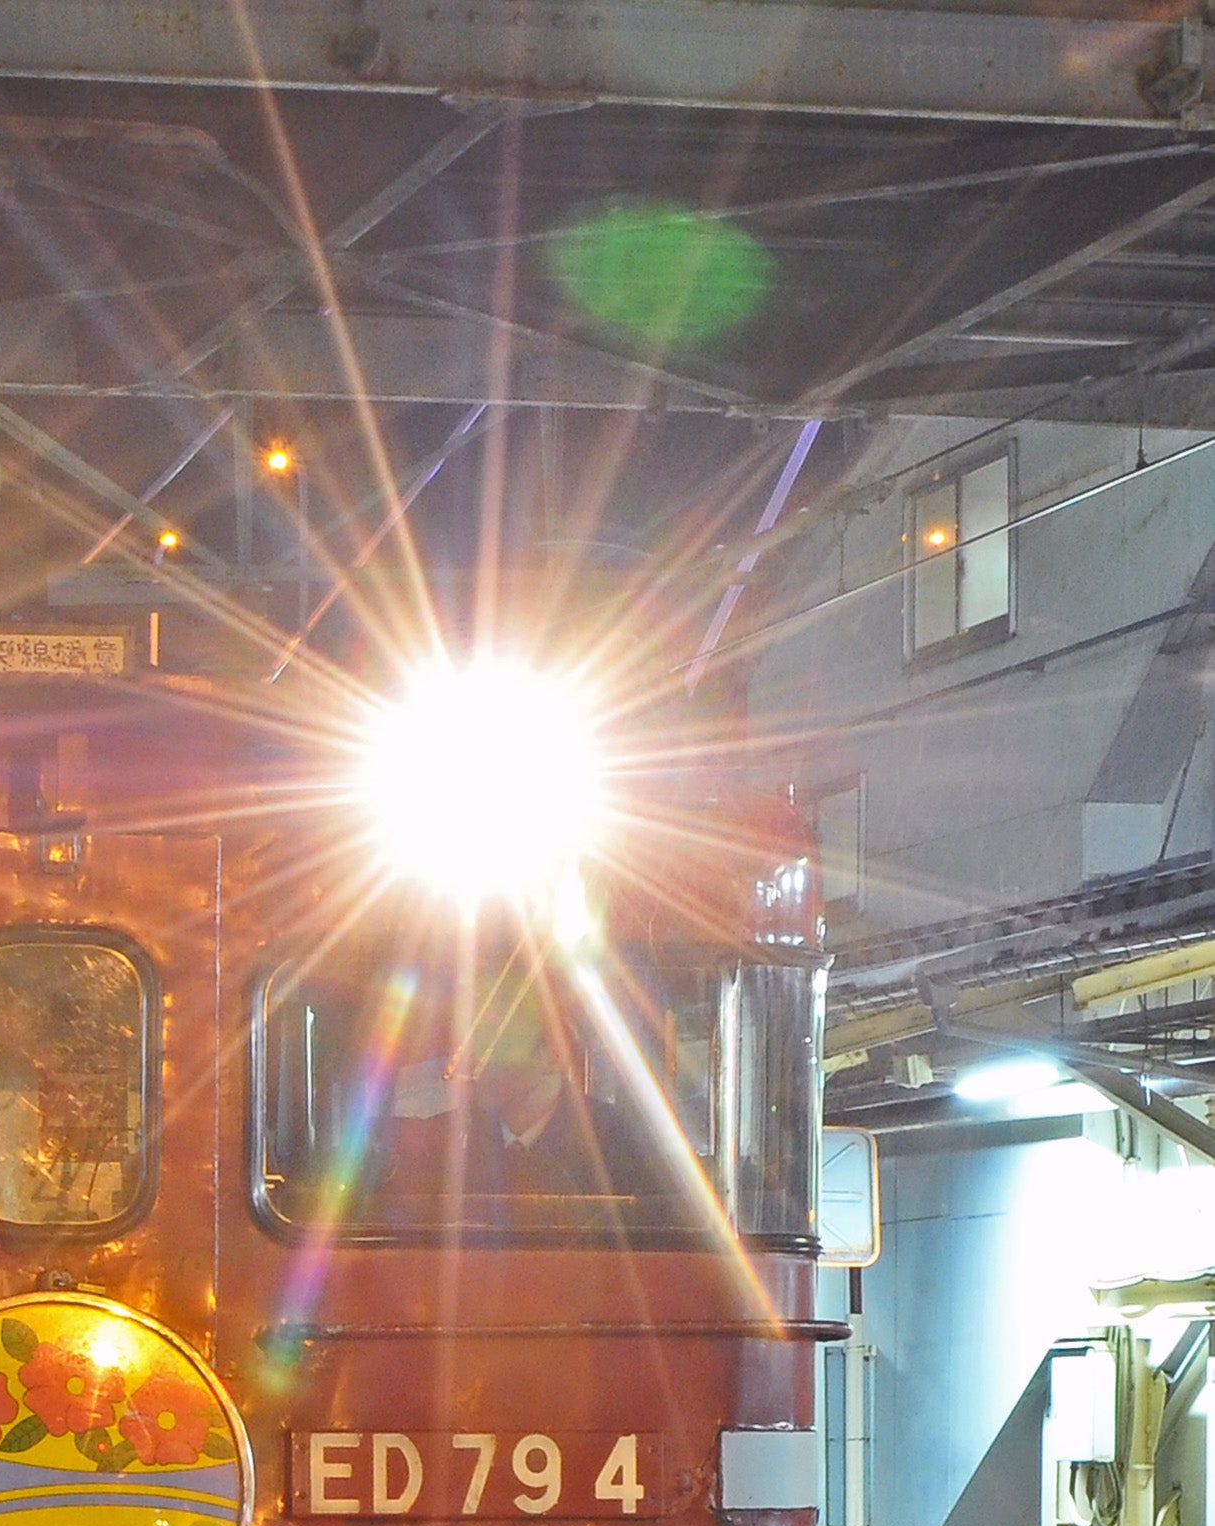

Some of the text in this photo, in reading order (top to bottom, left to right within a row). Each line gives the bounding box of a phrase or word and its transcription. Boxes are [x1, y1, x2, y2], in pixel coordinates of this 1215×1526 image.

[309, 1432, 645, 1515] ED 79 4
